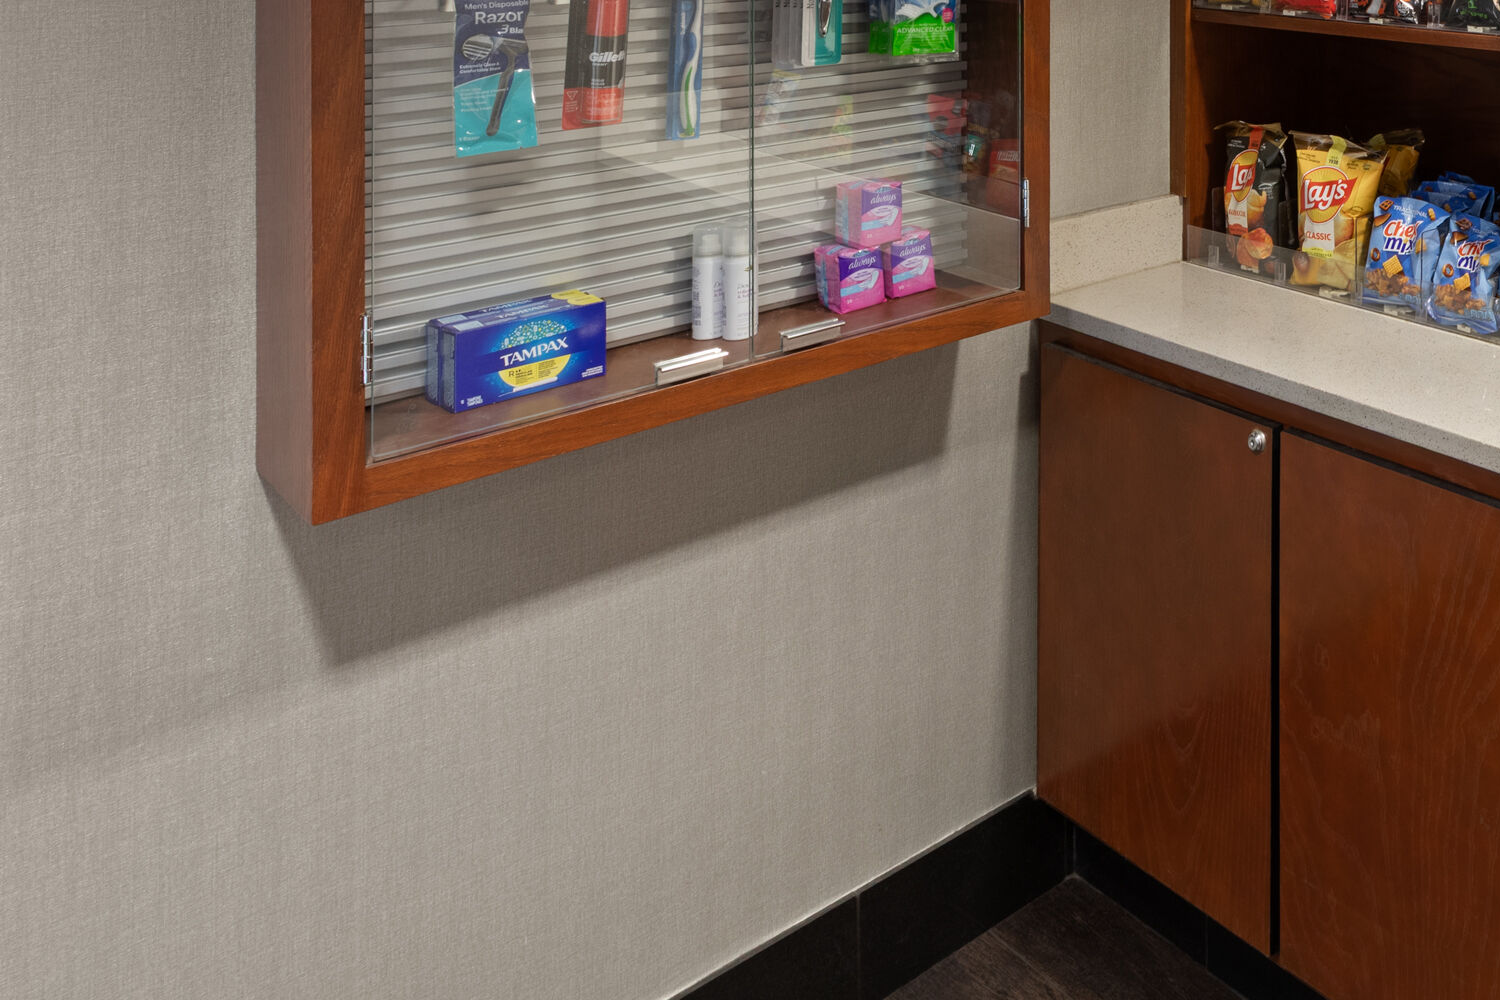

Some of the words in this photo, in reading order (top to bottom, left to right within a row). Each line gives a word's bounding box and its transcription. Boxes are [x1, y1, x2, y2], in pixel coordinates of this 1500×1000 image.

[475, 11, 524, 25] Razor
[870, 192, 897, 205] always
[1304, 179, 1348, 211] Lay's
[1305, 230, 1332, 241] CLASSIC
[899, 242, 926, 257] always
[1384, 237, 1416, 254] mix
[848, 255, 876, 270] always
[500, 337, 569, 367] TAMPAX
